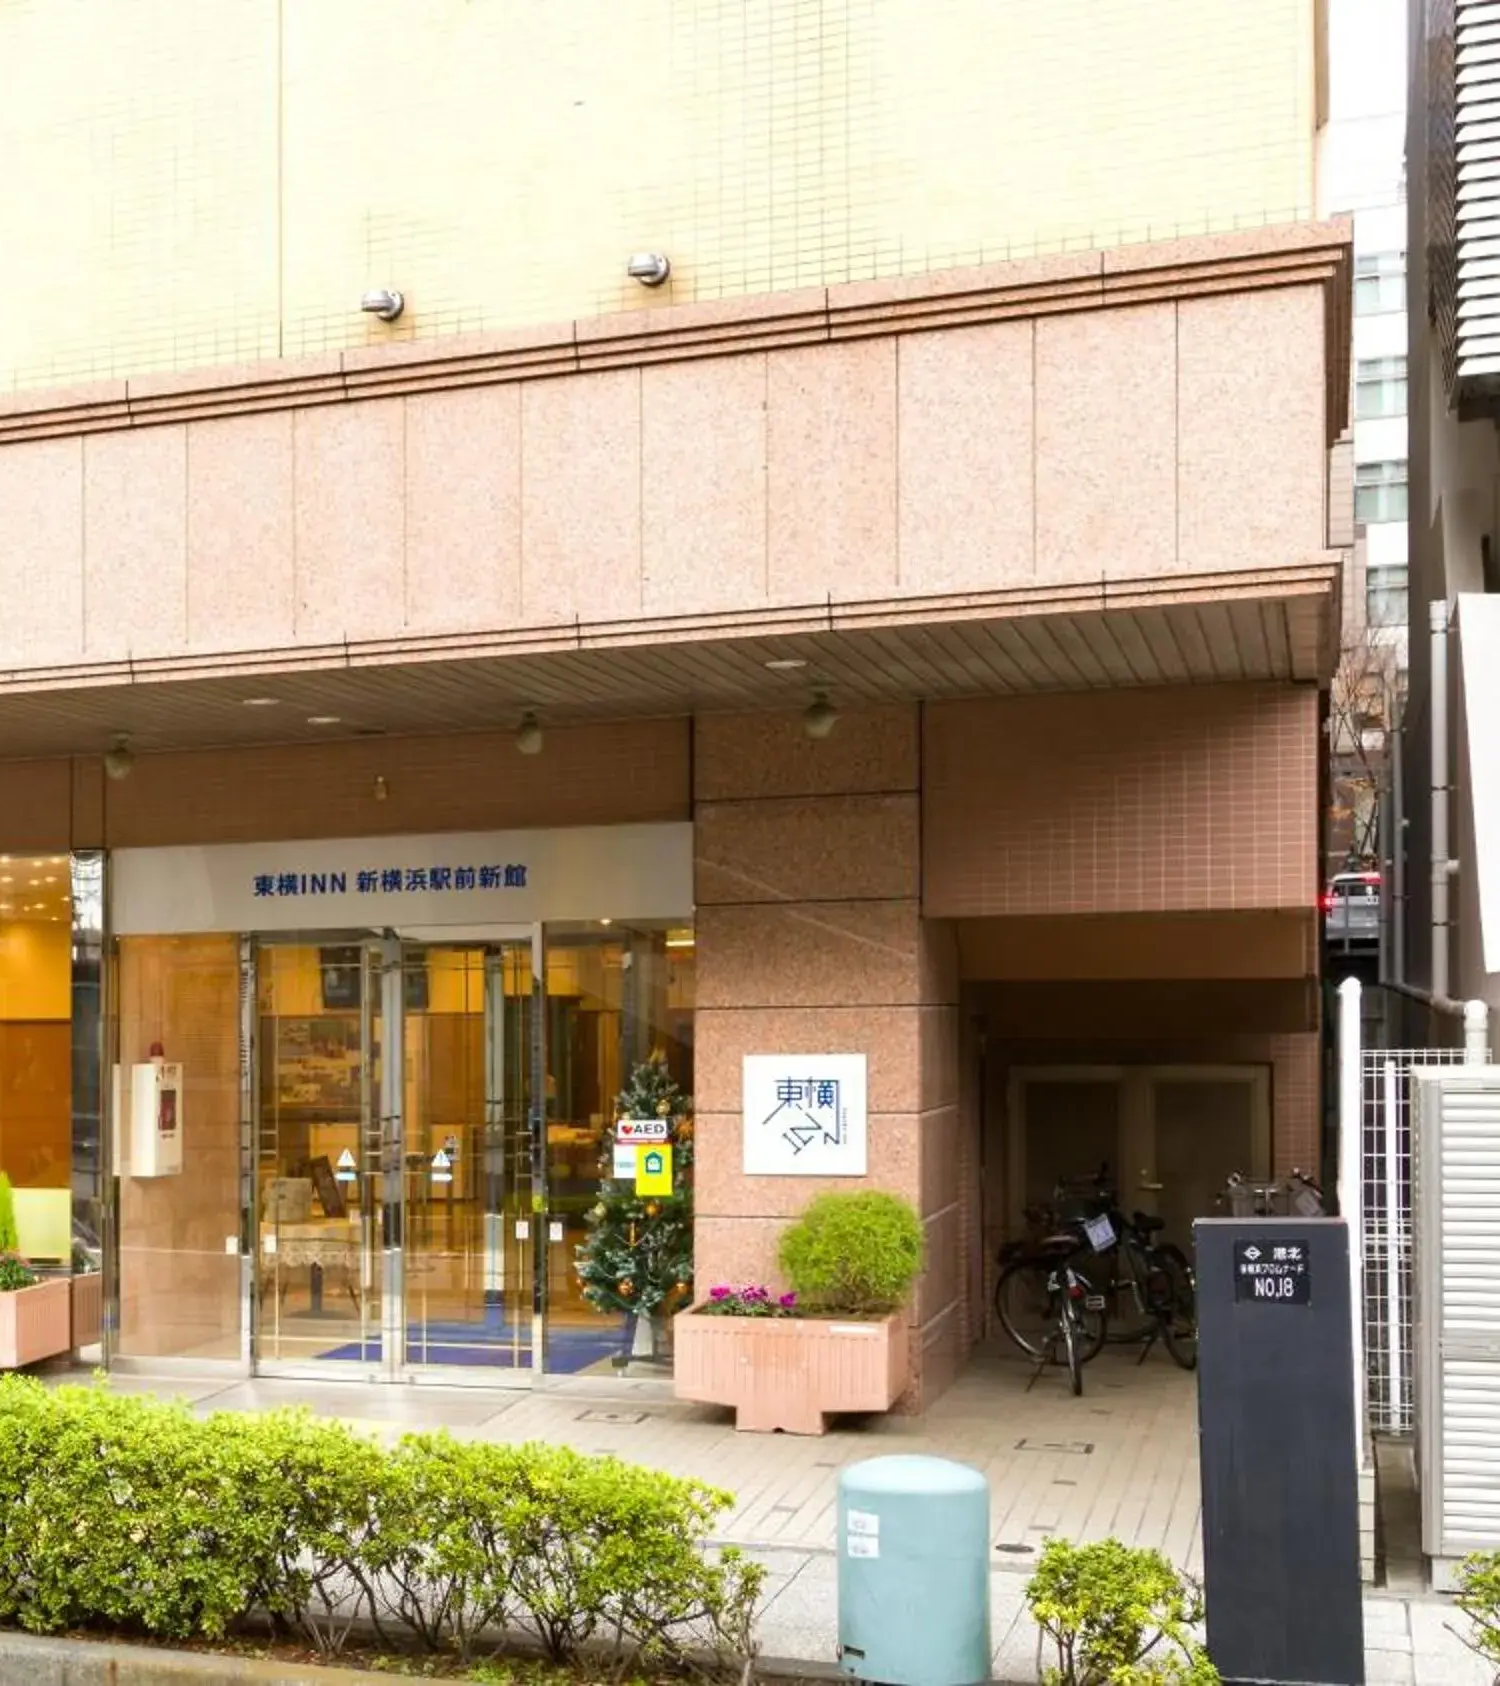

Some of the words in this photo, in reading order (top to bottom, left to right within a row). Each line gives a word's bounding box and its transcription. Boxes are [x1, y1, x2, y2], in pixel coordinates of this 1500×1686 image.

[253, 872, 347, 897] 東横INN
[356, 864, 527, 893] 新横浜駅前新館
[635, 1123, 665, 1135] AED
